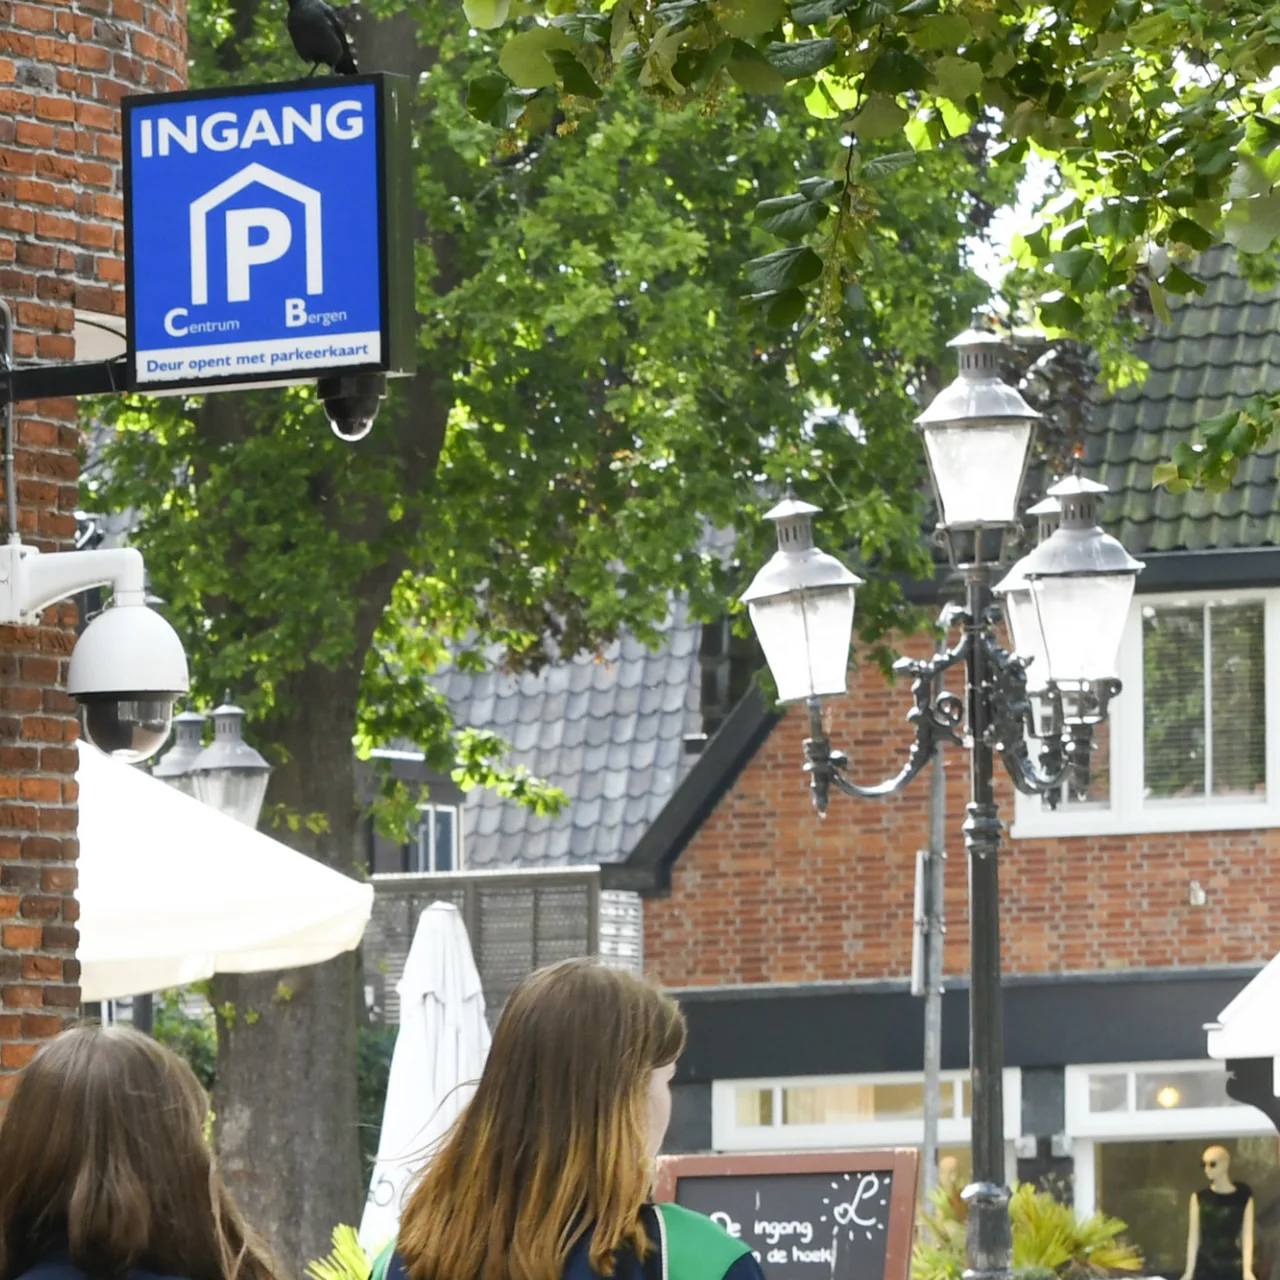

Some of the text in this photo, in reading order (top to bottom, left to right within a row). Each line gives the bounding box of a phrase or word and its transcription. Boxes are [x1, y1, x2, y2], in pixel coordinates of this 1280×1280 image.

[140, 100, 363, 158] INGANG
[164, 298, 347, 337] Centrum Bergen
[146, 342, 369, 374] Deur opent met parkeerkaart
[754, 1219, 814, 1244] ingang
[767, 1248, 788, 1264] de
[792, 1245, 832, 1264] hoek
